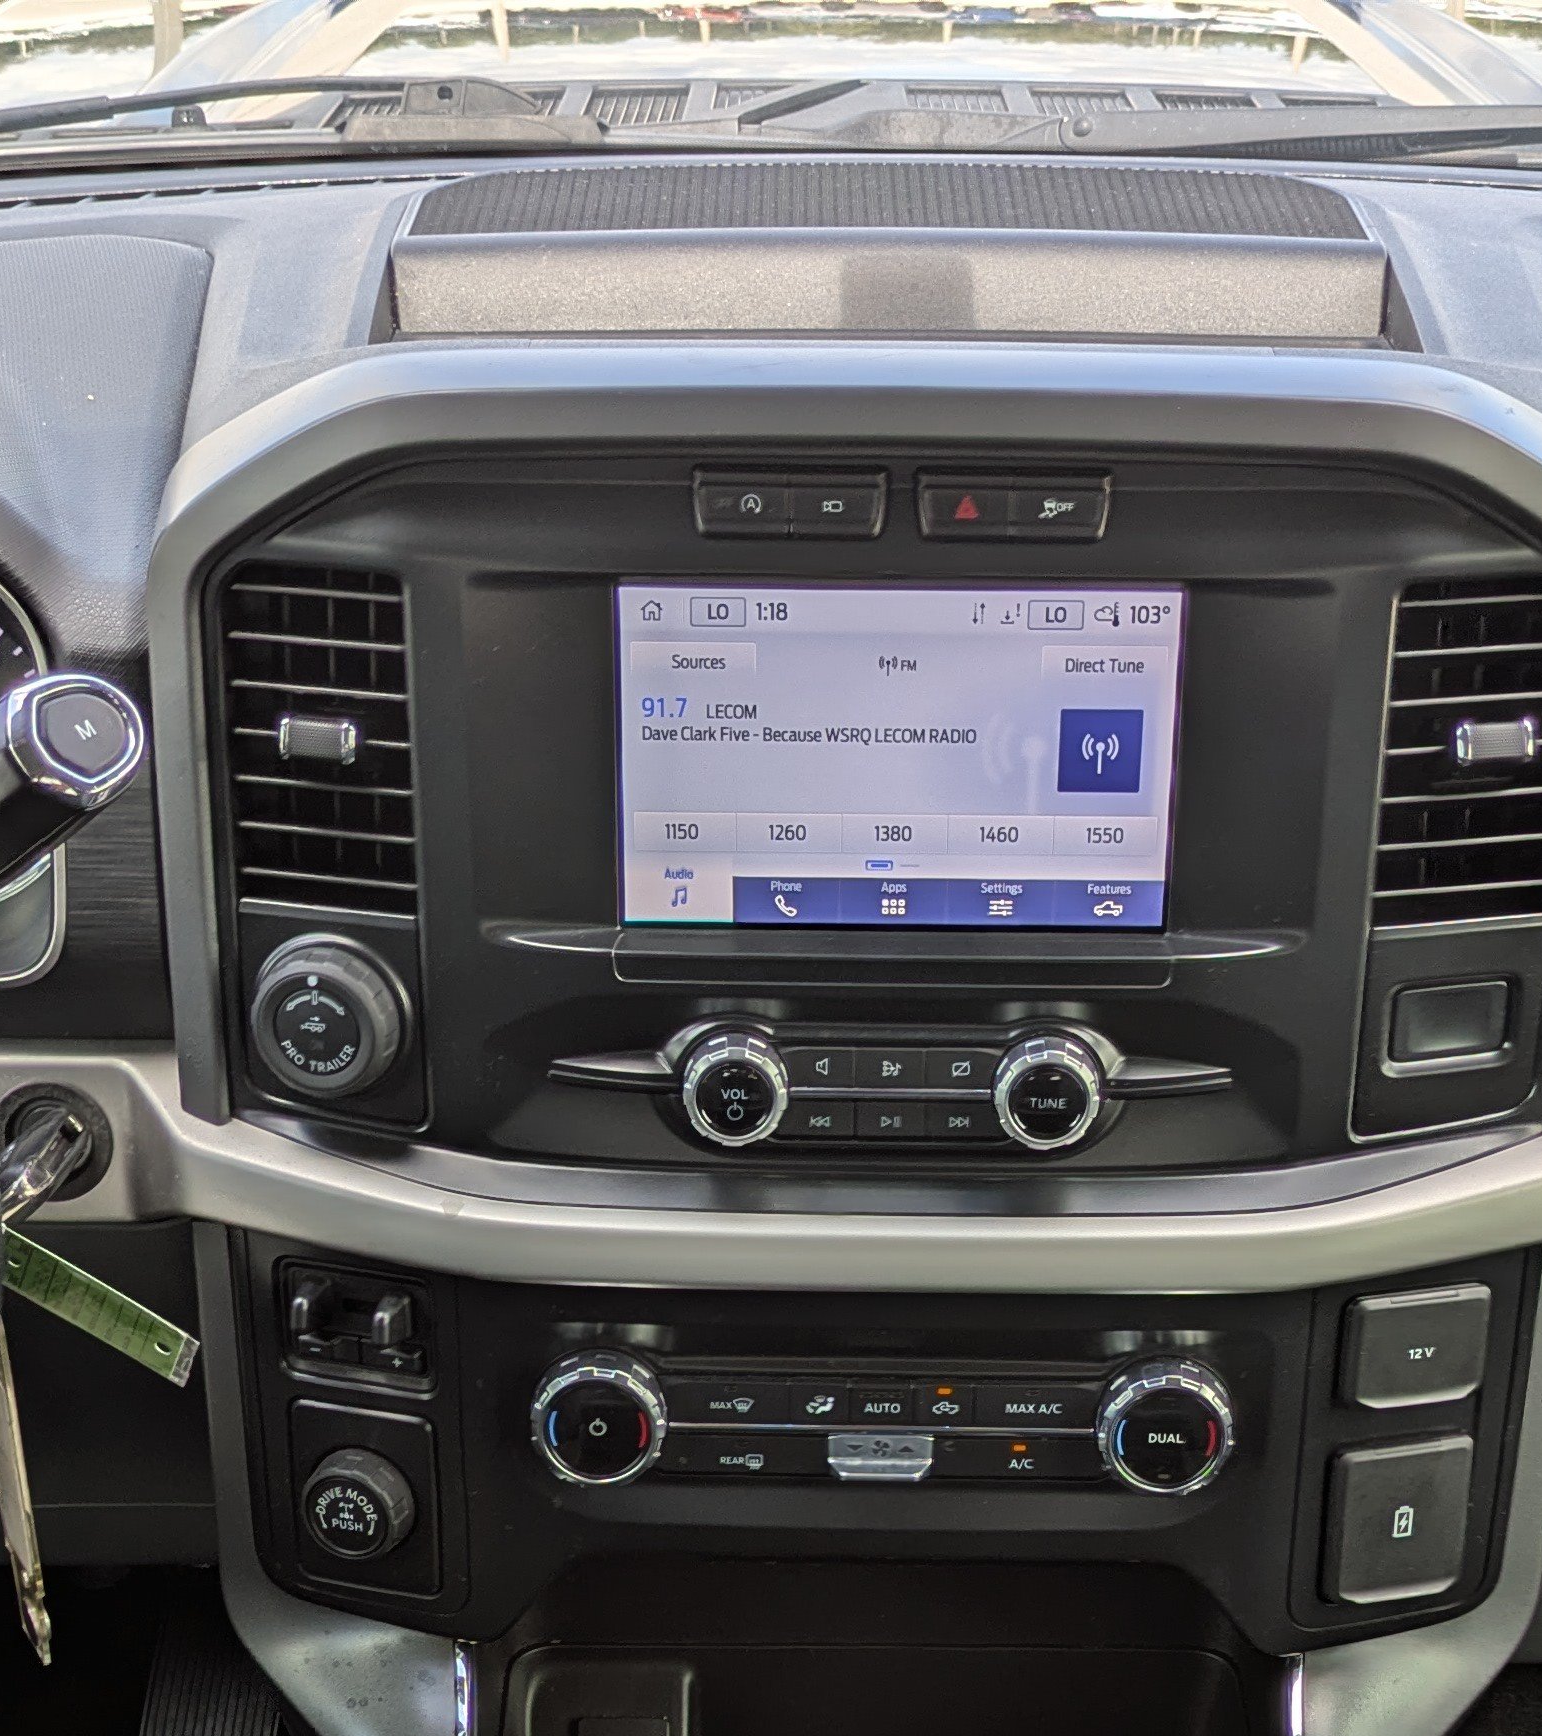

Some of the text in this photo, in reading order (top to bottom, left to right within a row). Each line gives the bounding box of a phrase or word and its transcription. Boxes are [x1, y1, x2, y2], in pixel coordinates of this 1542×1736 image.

[1056, 502, 1075, 512] OFF
[707, 603, 730, 621] LO
[756, 603, 788, 622] 1:18
[1045, 606, 1067, 624] LO
[1130, 605, 1171, 625] 103°
[671, 653, 726, 671] Sources
[900, 658, 917, 672] FM
[1064, 657, 1145, 674] Direct Tune
[641, 697, 688, 718] 91.7
[706, 704, 757, 720] LECOM
[74, 720, 98, 741] M
[642, 726, 678, 741] Dave
[680, 726, 717, 742] Clark
[720, 726, 750, 742] Five
[762, 727, 822, 743] Because
[825, 728, 872, 746] WSRQ
[874, 728, 926, 743] LECOM
[929, 729, 977, 744] RADIO
[664, 824, 699, 841] 1150
[768, 824, 807, 842] 1260
[874, 825, 913, 843] 1380
[979, 826, 1019, 844] 1460
[1086, 827, 1124, 845] 1550
[664, 867, 694, 881] Audio
[770, 880, 802, 893] Phone
[881, 881, 907, 896] Apps
[980, 881, 1023, 897] Settings
[1087, 882, 1132, 896] Features
[281, 1040, 356, 1072] PRO TRAILER
[721, 1089, 749, 1100] VOL
[1029, 1097, 1067, 1110] TUNE
[709, 1401, 733, 1410] MAX
[864, 1402, 901, 1414] AUTO
[1005, 1403, 1063, 1416] MAX A/C
[1148, 1433, 1184, 1445] DUAL
[719, 1455, 745, 1465] REAR
[1009, 1458, 1035, 1470] A/C
[316, 1486, 378, 1522] DRIVE MODE
[332, 1518, 364, 1533] PUSH
